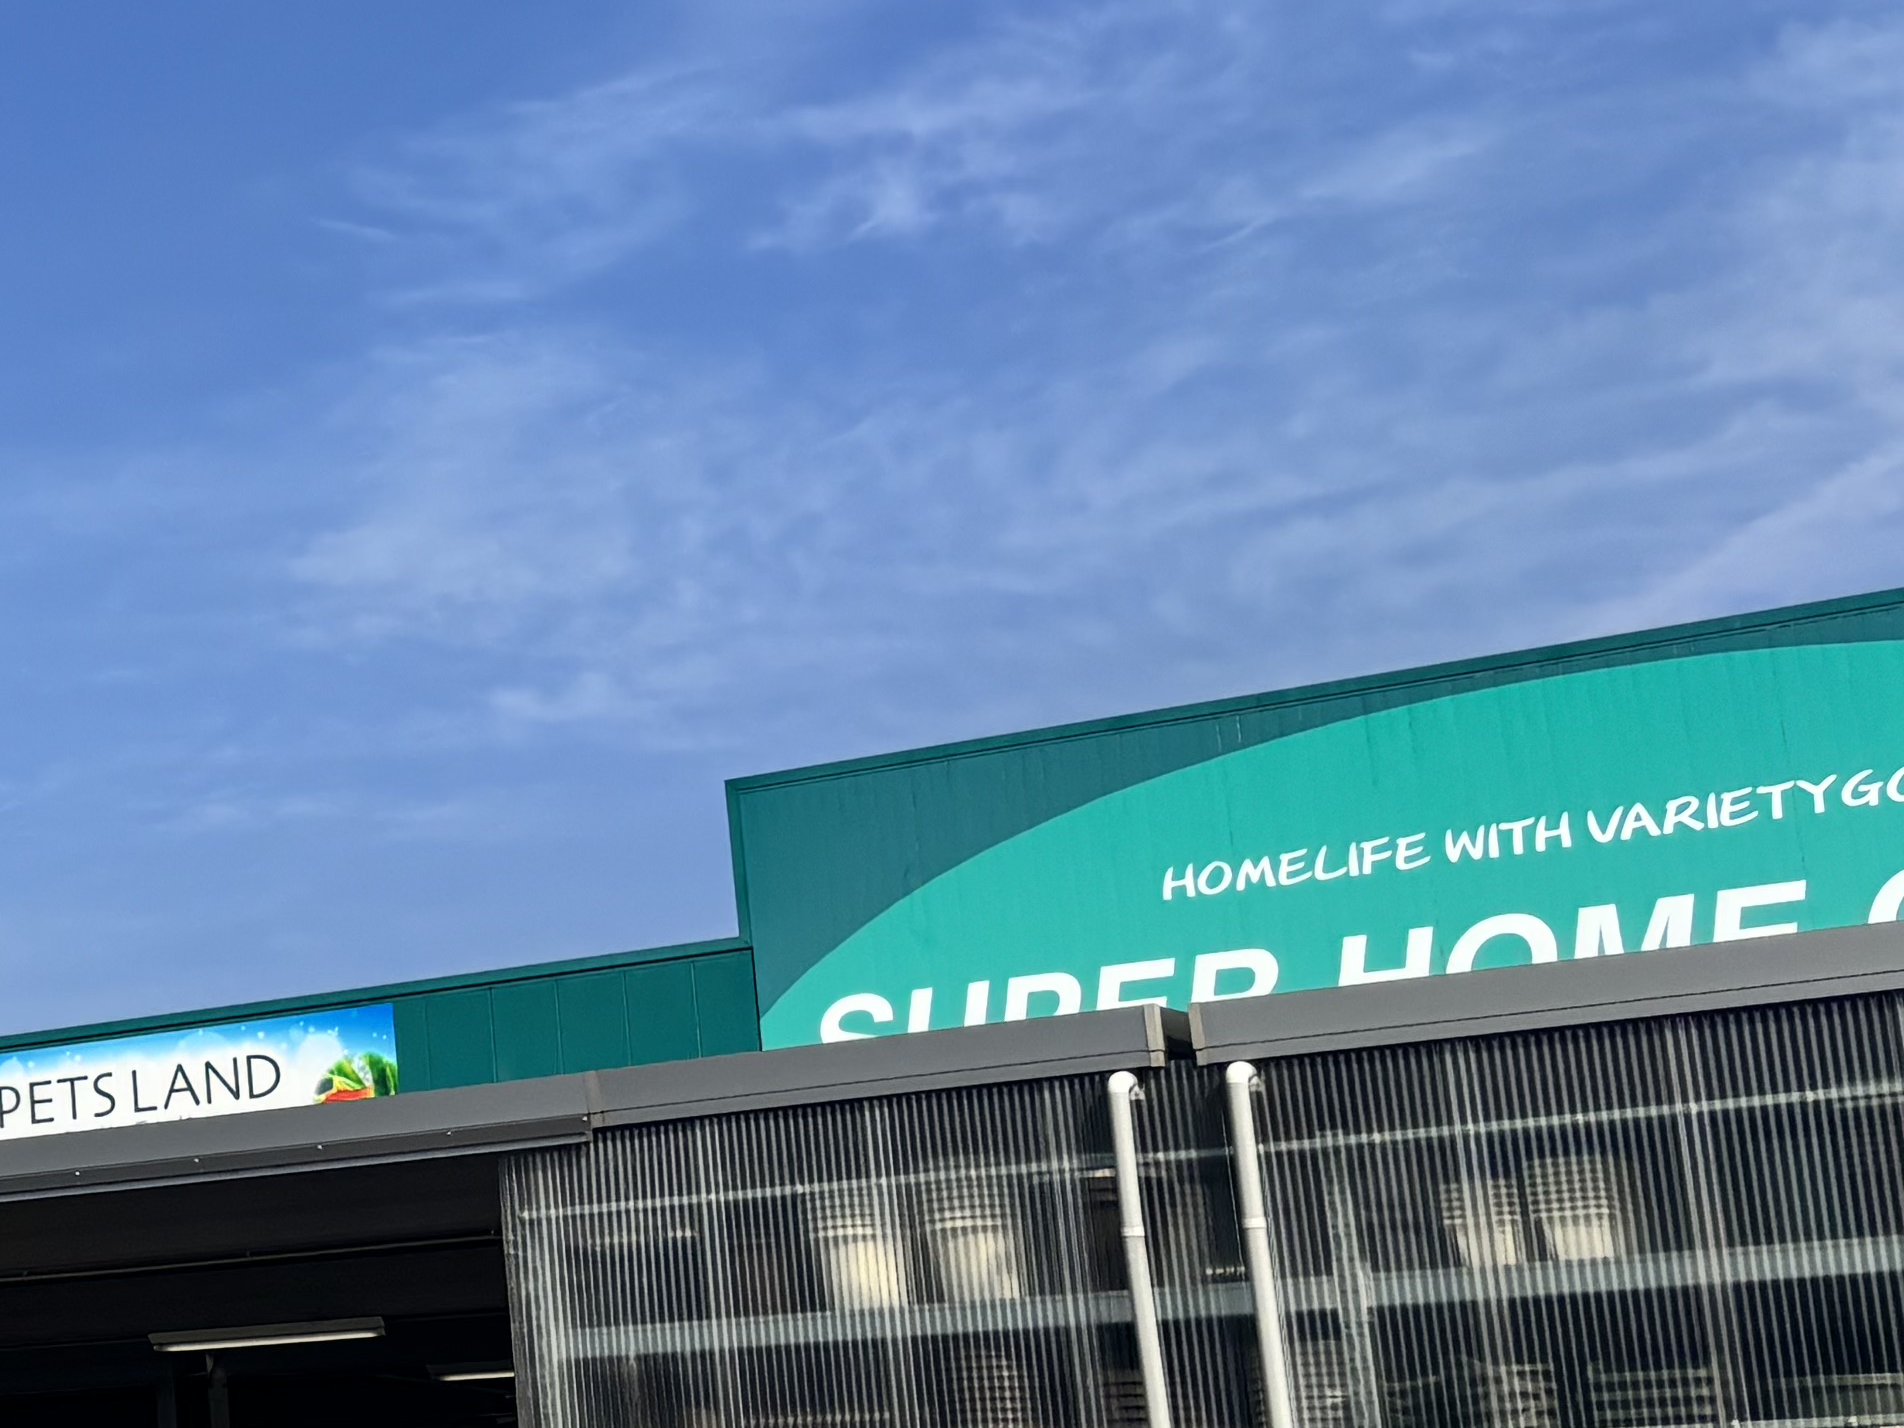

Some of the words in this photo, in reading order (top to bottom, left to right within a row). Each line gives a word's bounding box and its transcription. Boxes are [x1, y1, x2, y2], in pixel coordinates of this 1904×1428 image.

[1163, 830, 1431, 902] HOMELIFE
[1444, 811, 1572, 865] WITH
[132, 1053, 281, 1113] LAND
